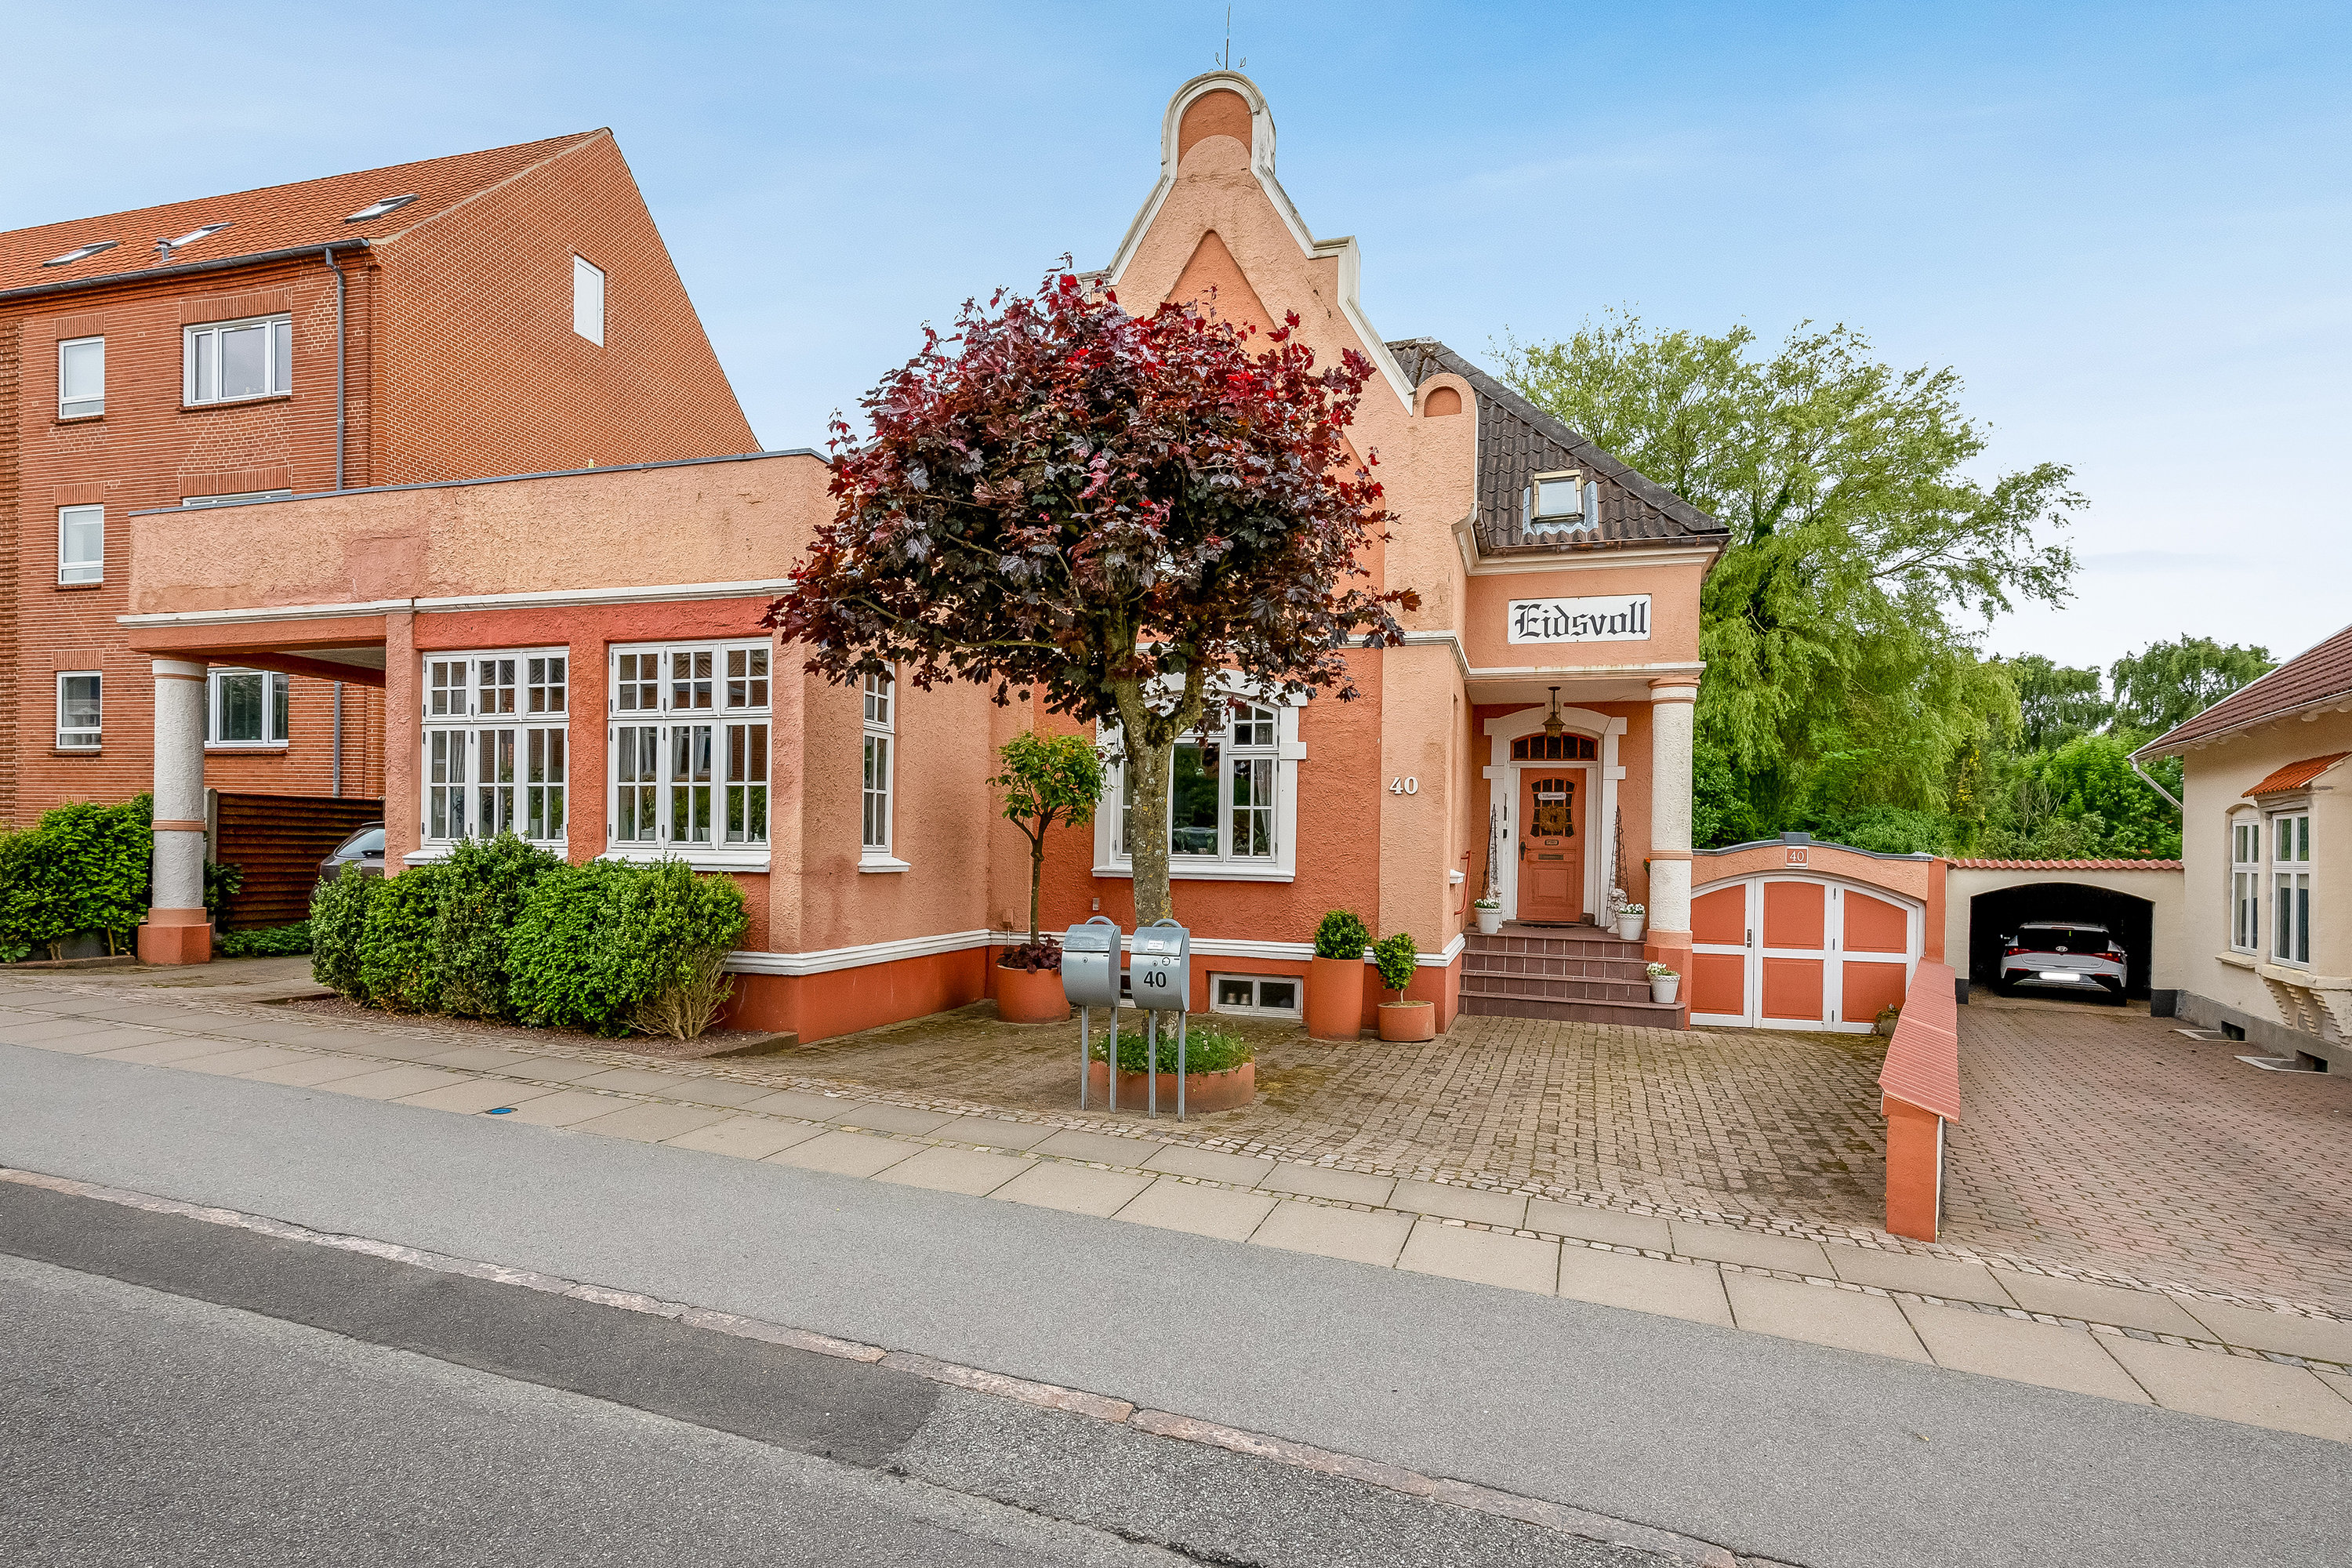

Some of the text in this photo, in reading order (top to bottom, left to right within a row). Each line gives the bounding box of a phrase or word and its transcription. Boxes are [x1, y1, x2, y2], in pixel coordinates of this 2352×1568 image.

[1513, 601, 1647, 638] Eidsvoll
[1389, 776, 1418, 795] 40
[1789, 851, 1805, 862] 40
[1143, 971, 1167, 988] 40
